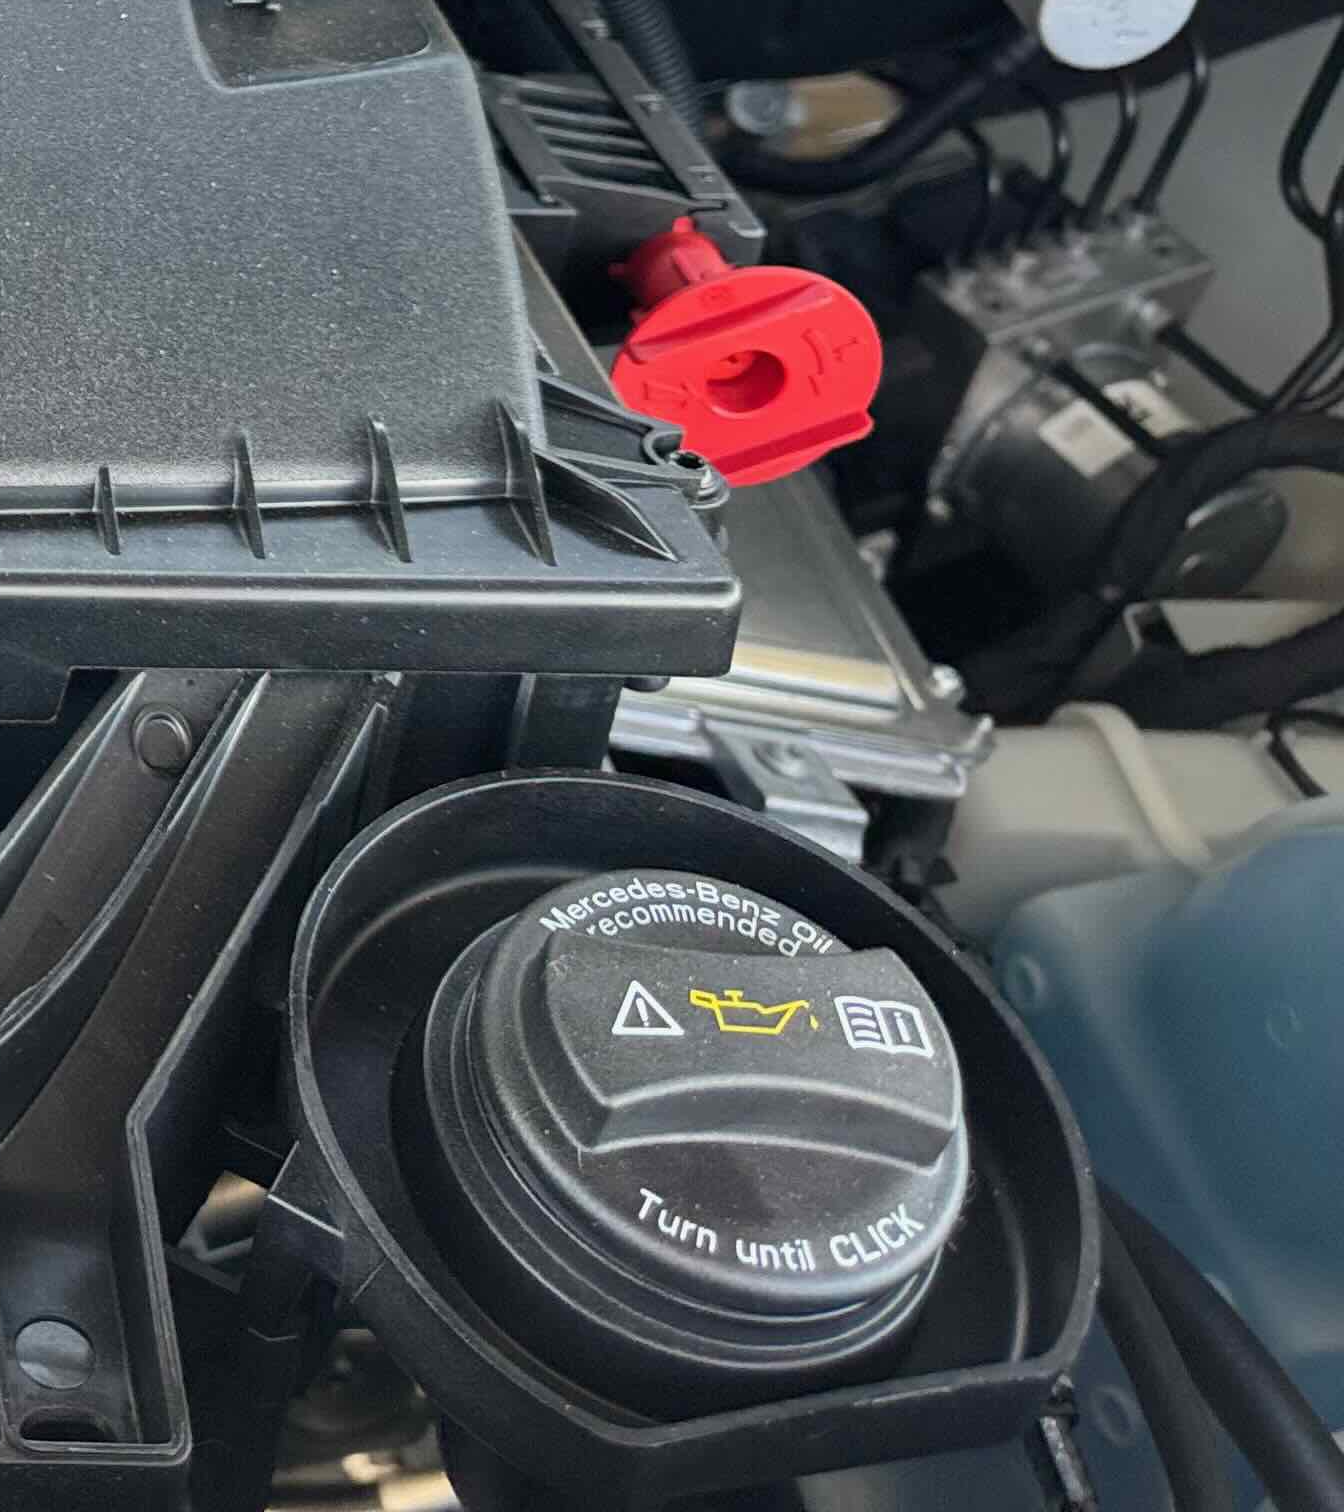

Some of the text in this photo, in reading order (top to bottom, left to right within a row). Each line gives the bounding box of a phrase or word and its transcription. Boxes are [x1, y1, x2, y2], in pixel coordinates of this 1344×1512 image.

[539, 877, 833, 954] Mercedes-Benz Oil
[586, 903, 801, 958] recommended
[638, 1187, 926, 1272] Turn until CLICK
